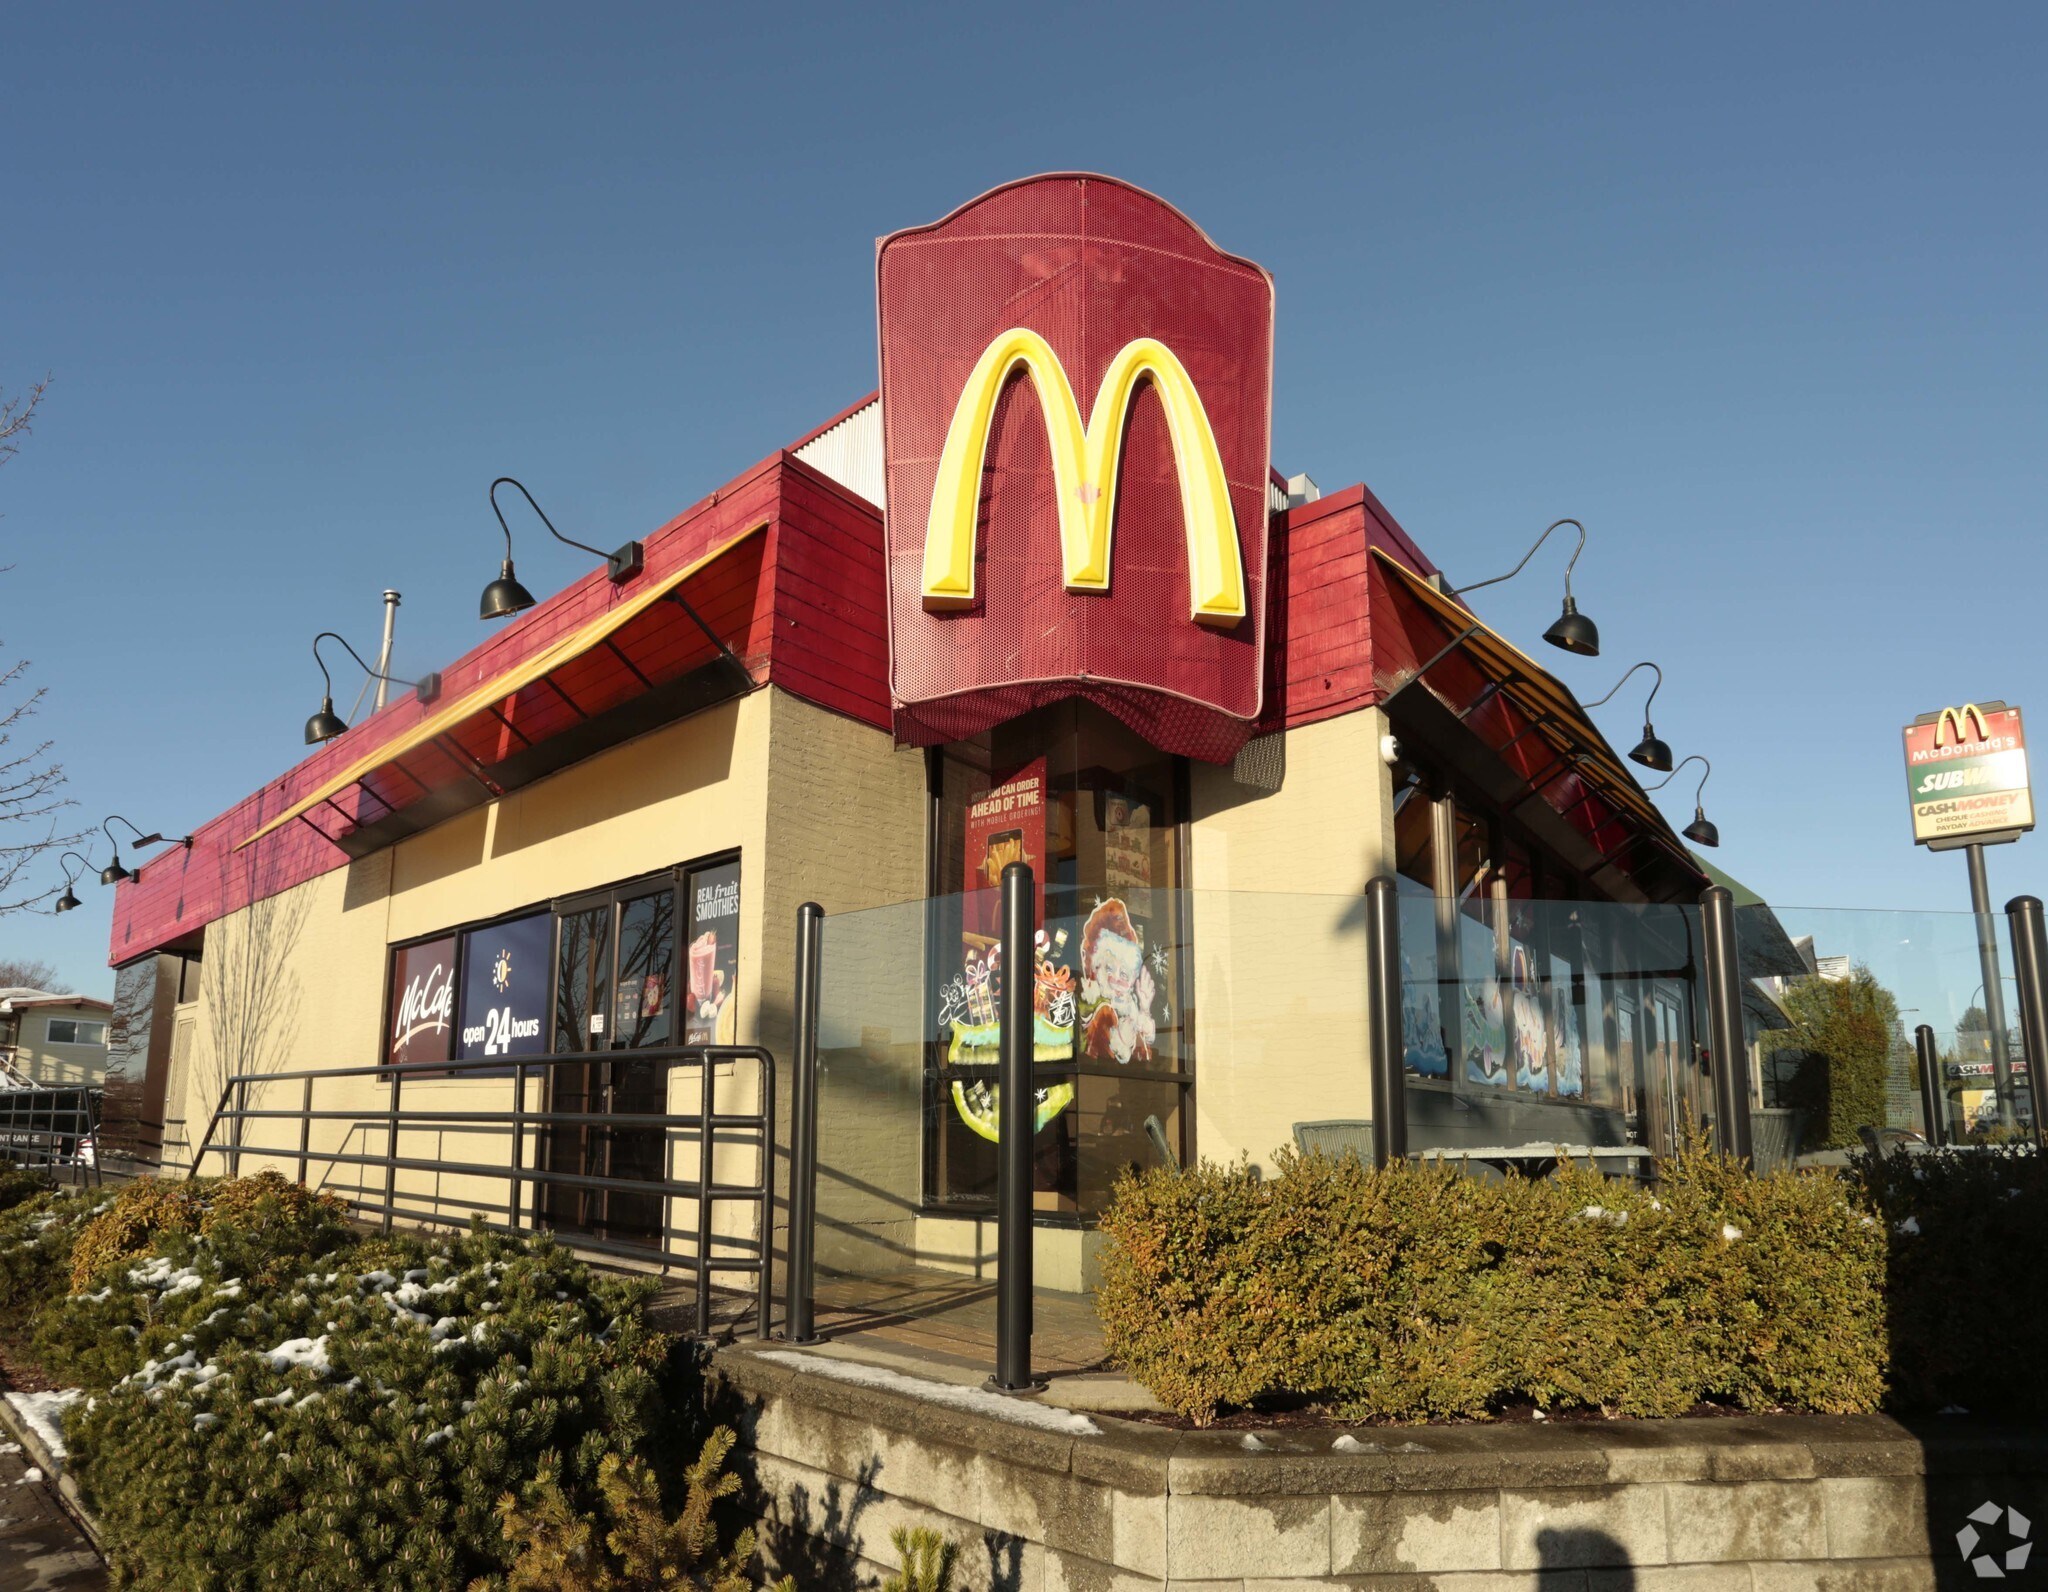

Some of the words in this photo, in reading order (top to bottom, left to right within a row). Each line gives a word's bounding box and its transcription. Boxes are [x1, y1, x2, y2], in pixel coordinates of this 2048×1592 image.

[1912, 736, 2016, 762] McDonald's
[987, 787, 1001, 799] YOU
[1001, 782, 1016, 796] CAN
[1017, 778, 1040, 792] ORDER
[971, 799, 1001, 819] AHEAD
[1003, 796, 1016, 811] OF
[1017, 790, 1040, 808] TIME
[971, 819, 985, 829] WITH
[987, 813, 1007, 825] MOBILE
[1936, 814, 1968, 824] CHEQUE
[1969, 808, 2008, 820] CASHING
[1936, 822, 1968, 832] PAYDAY
[1968, 817, 2009, 828] ADVANCE
[697, 885, 714, 903] REAL
[714, 880, 739, 900] fruit
[696, 895, 739, 922] SMOOTHIES
[463, 1025, 486, 1048] open
[484, 1006, 511, 1056] 24
[511, 1017, 539, 1038] hours
[0, 1134, 40, 1143] NTRANE
